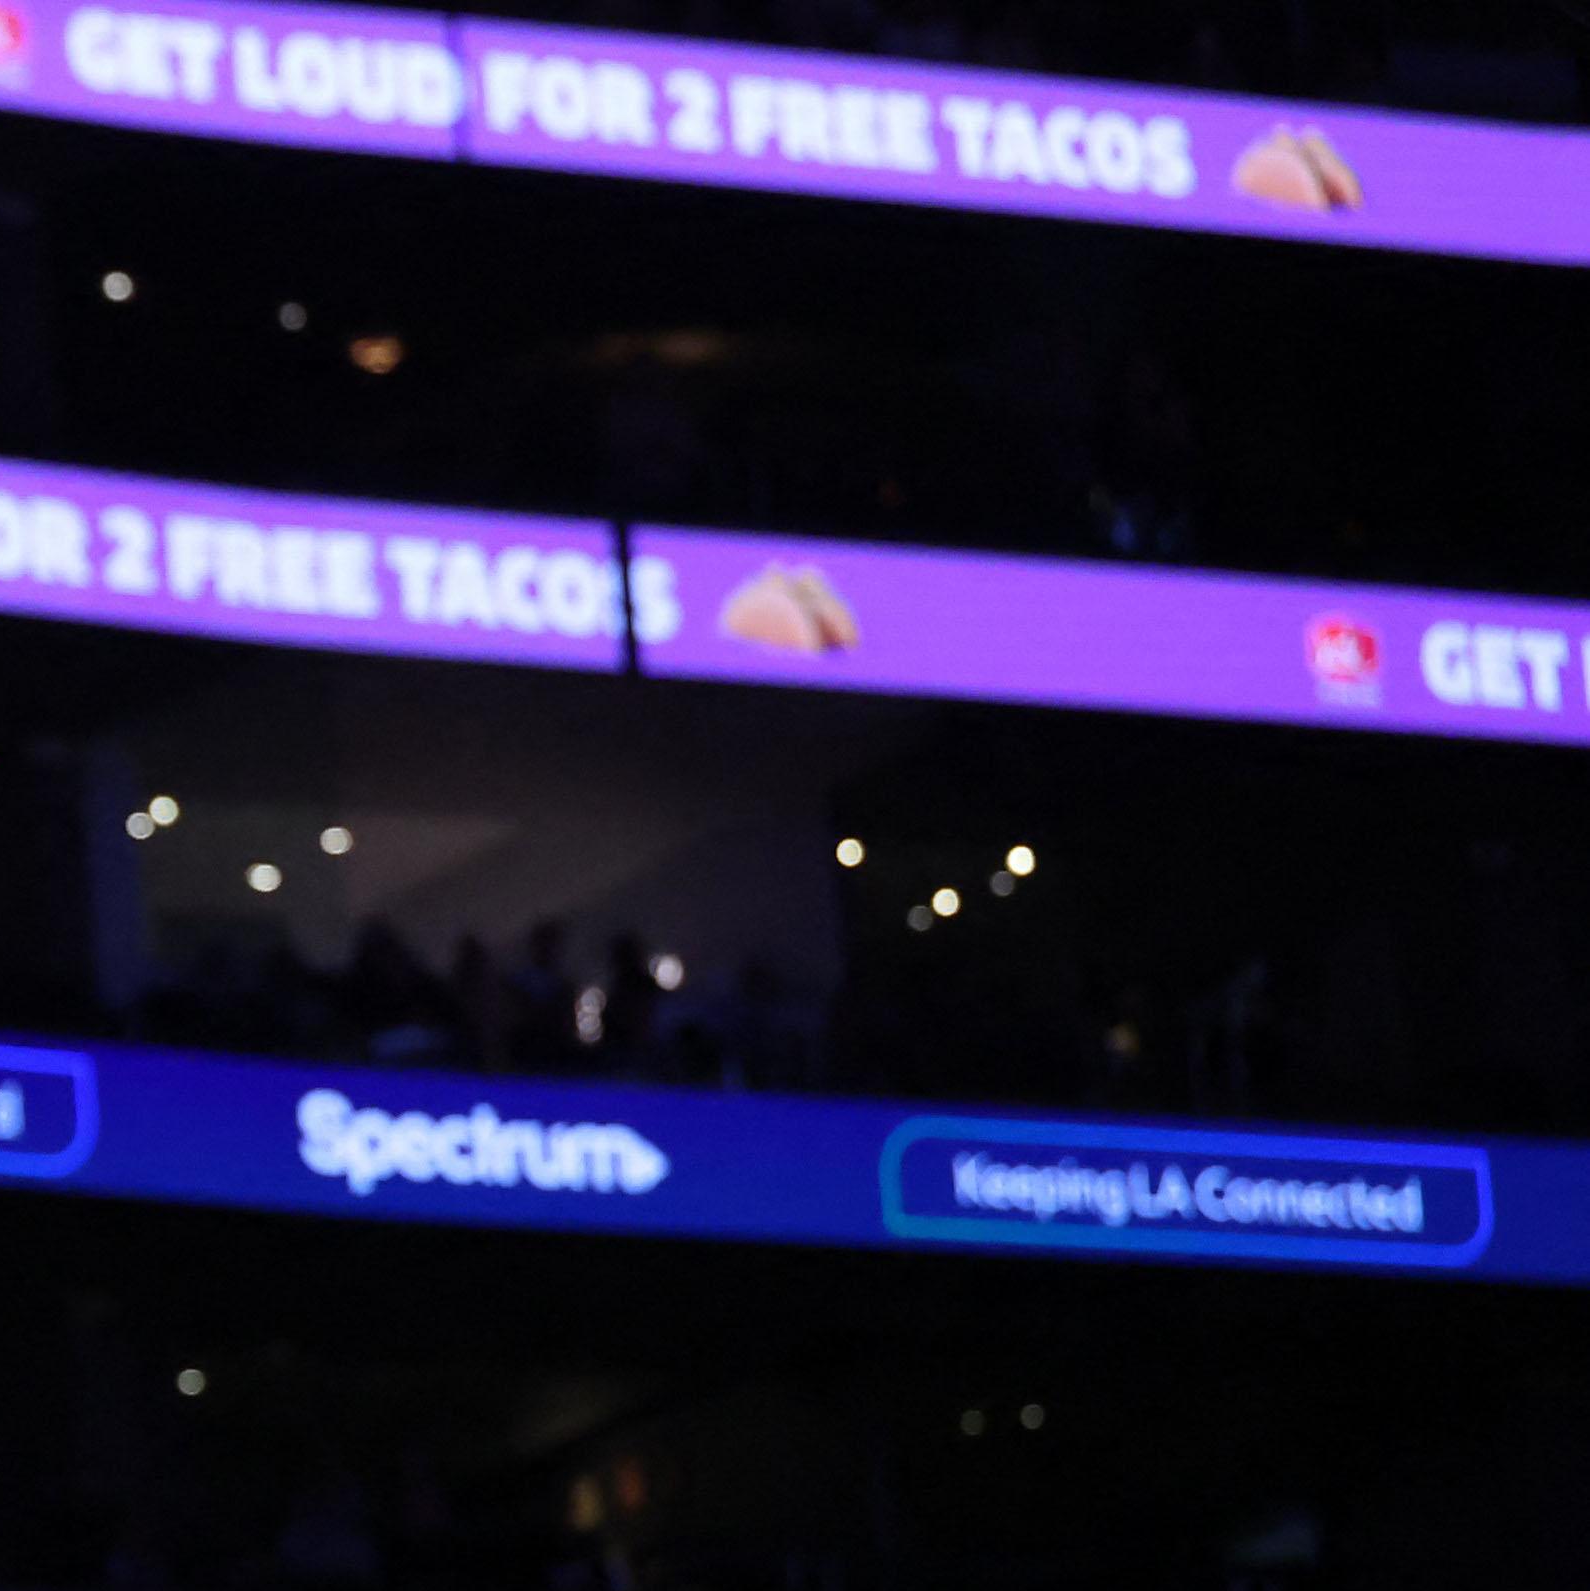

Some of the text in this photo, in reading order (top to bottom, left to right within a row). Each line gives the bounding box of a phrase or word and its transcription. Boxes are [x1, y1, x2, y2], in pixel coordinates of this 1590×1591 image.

[65, 7, 218, 103] GET
[232, 26, 465, 128] LOUD
[483, 50, 656, 147] FOR
[666, 70, 723, 152] 2
[729, 74, 936, 172] FREE
[943, 96, 1197, 198] TACOS
[101, 504, 159, 597] 2
[164, 512, 379, 619] FREE
[384, 533, 682, 645] TACOS
[1420, 620, 1569, 712] GET
[296, 1088, 669, 1193] Spectrum
[1127, 1162, 1196, 1219] LA
[1195, 1165, 1424, 1228] Connected
